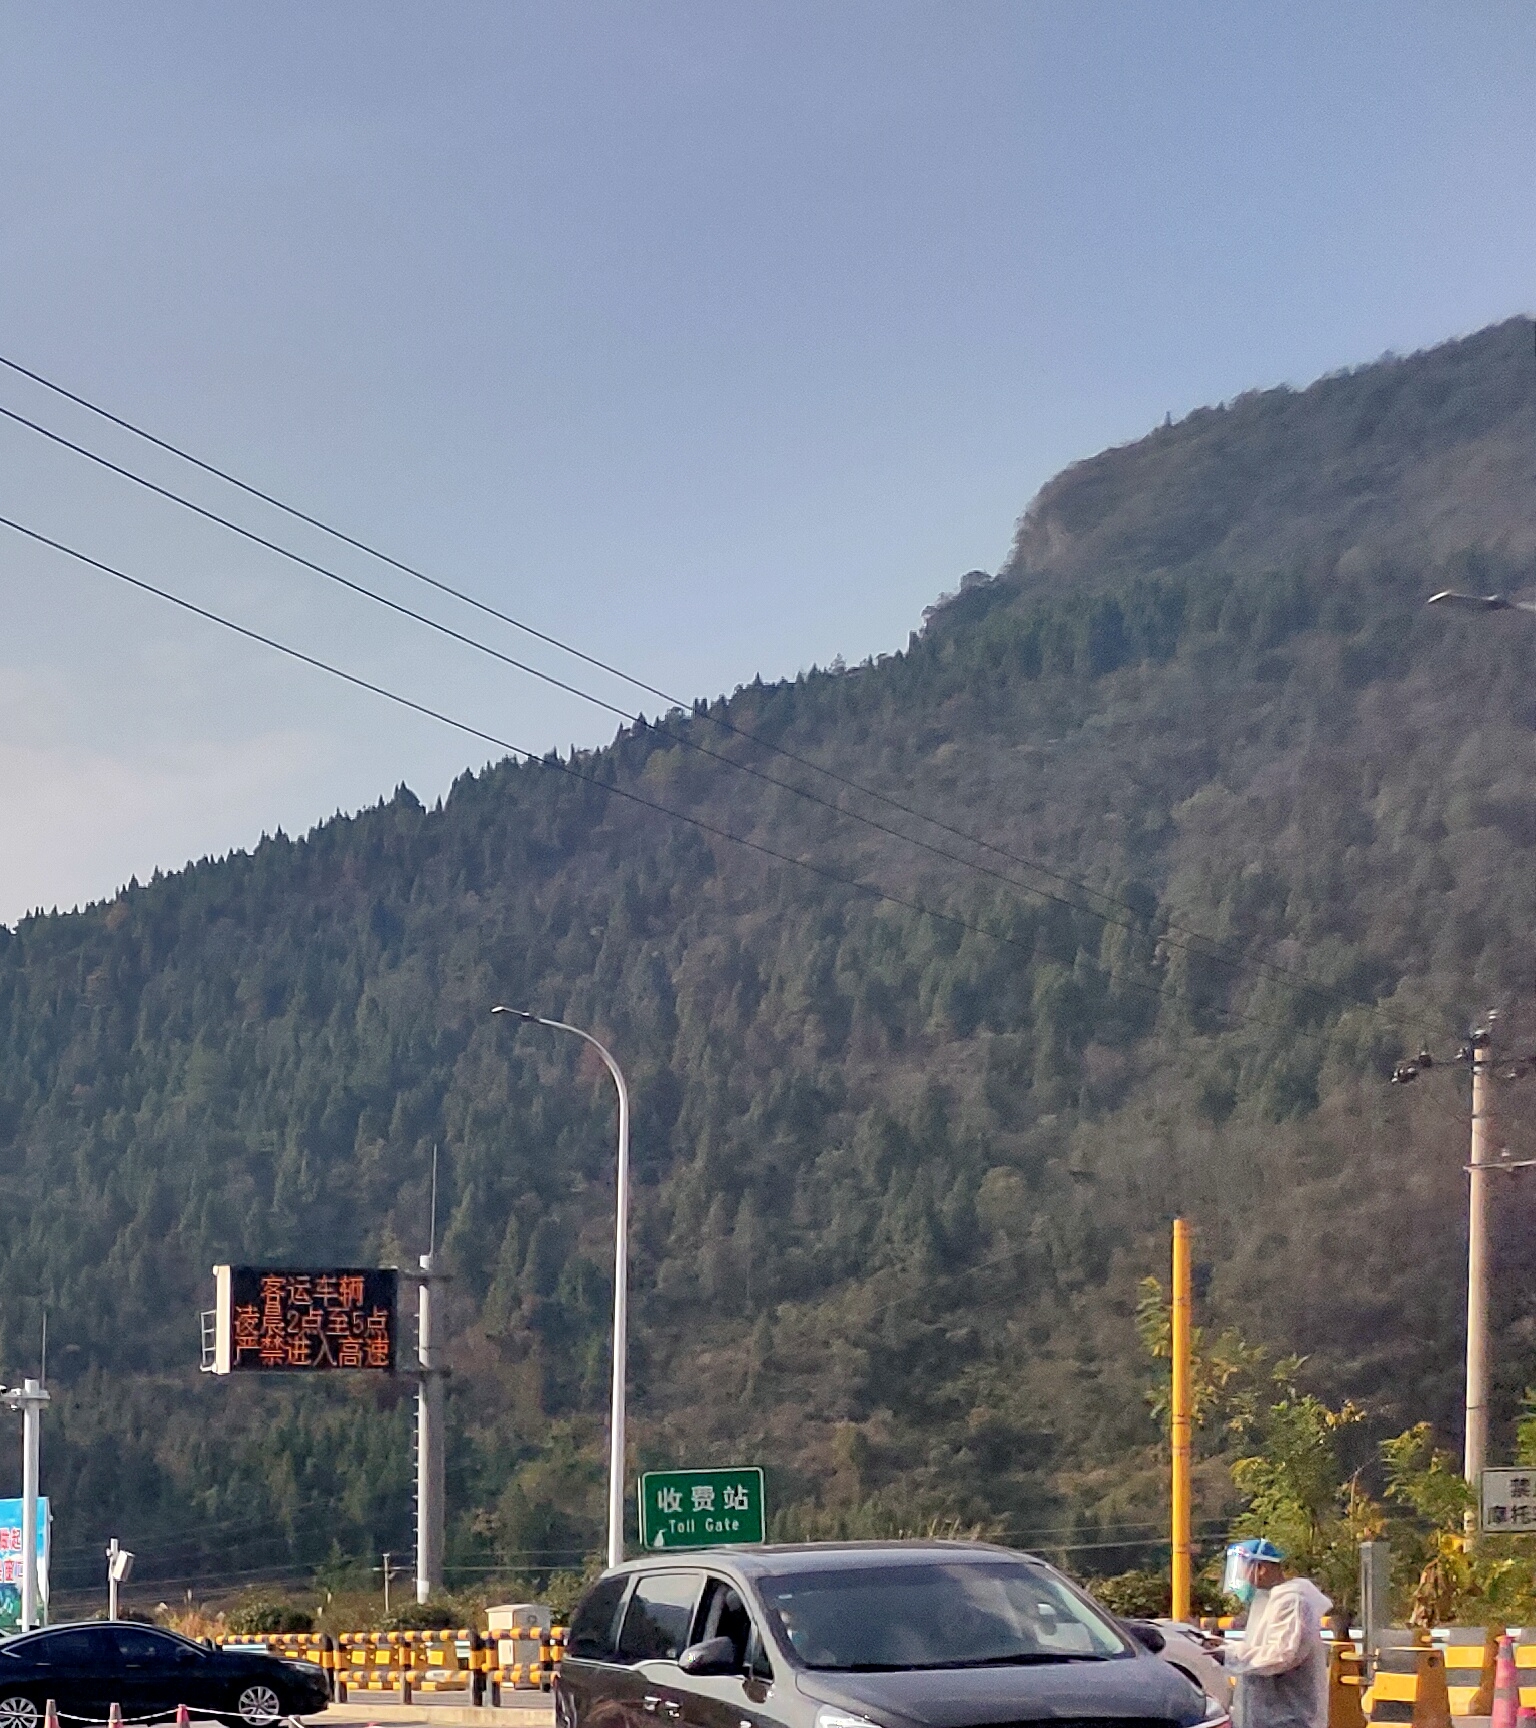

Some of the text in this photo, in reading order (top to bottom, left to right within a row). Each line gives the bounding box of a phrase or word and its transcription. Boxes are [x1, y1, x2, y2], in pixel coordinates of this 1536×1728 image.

[260, 1275, 364, 1306] 客运车辆
[235, 1303, 389, 1335] 凌晨2点至5点
[235, 1336, 390, 1366] 严禁进入高速
[657, 1484, 749, 1513] 收费站
[668, 1518, 739, 1534] Toll Gate
[1488, 1506, 1536, 1524] 摩托
